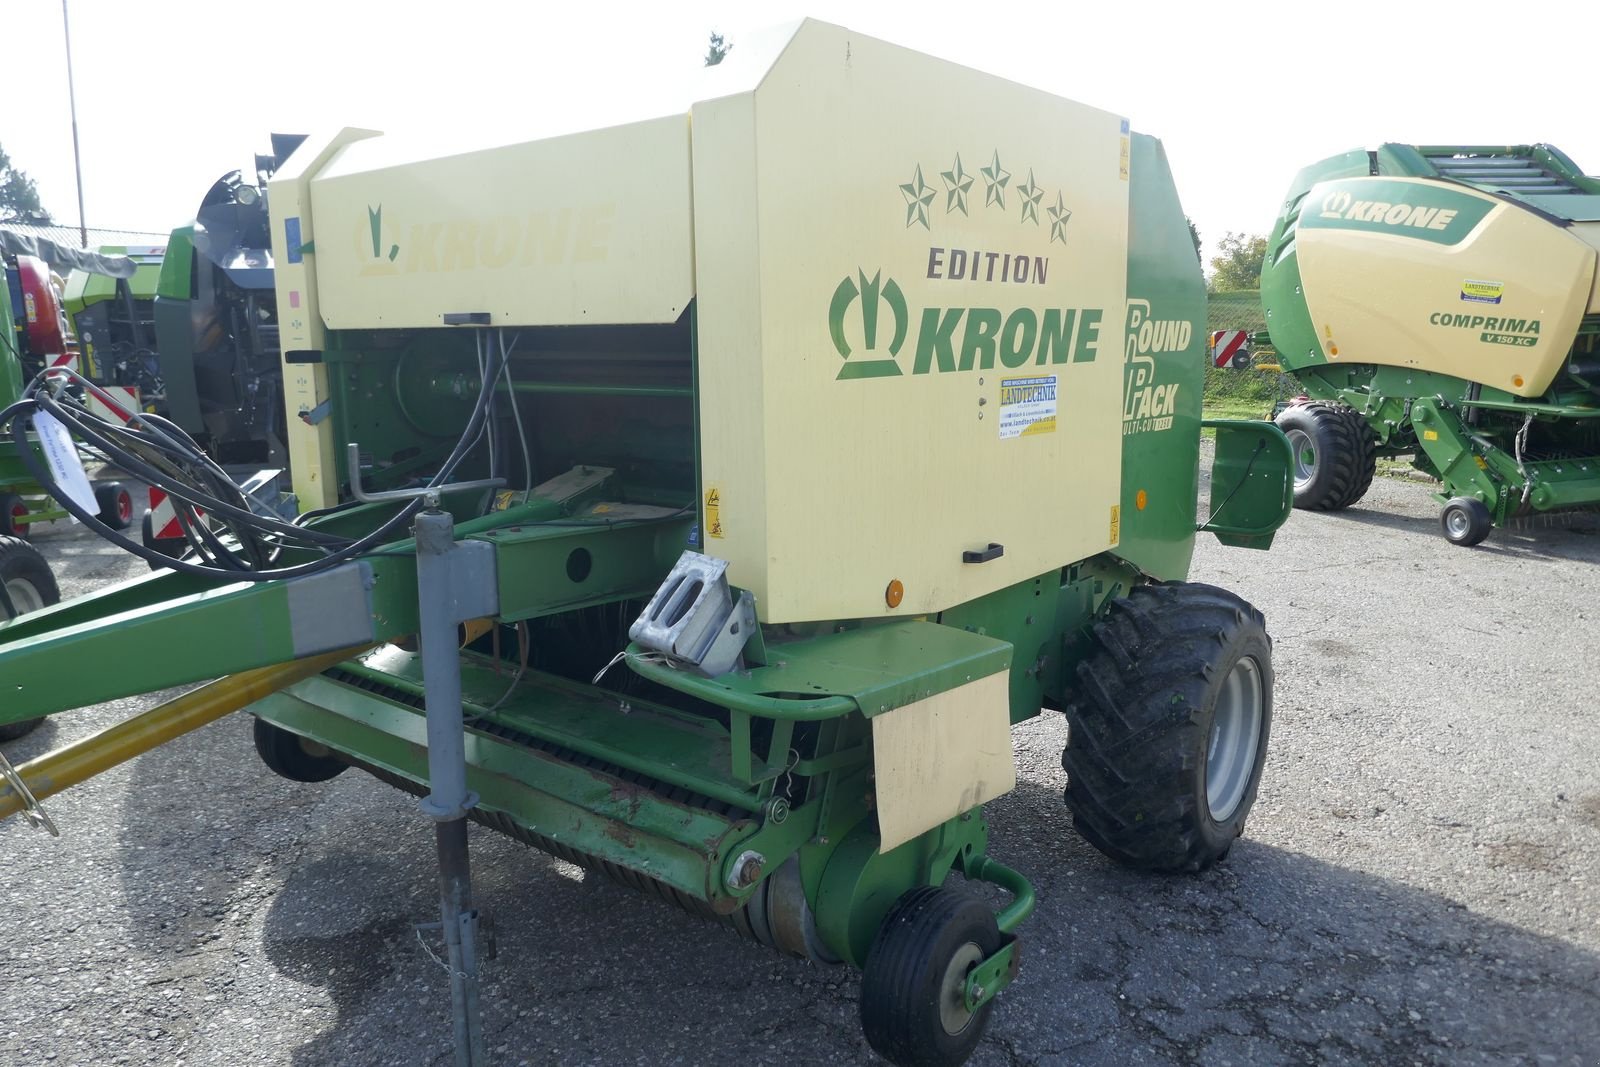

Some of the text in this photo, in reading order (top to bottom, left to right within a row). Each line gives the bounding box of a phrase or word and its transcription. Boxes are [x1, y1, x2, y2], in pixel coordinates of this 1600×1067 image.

[1344, 200, 1459, 231] KRONE
[926, 247, 1049, 285] EDITION
[1125, 298, 1192, 362] ROUND
[1429, 312, 1541, 335] COMPRIMA
[912, 307, 1104, 375] KRONE
[1486, 334, 1531, 346] V 150 XC
[1001, 385, 1056, 405] LANDTECHNIK
[1122, 356, 1179, 421] PACK
[1123, 417, 1157, 435] ULTI-CUT
